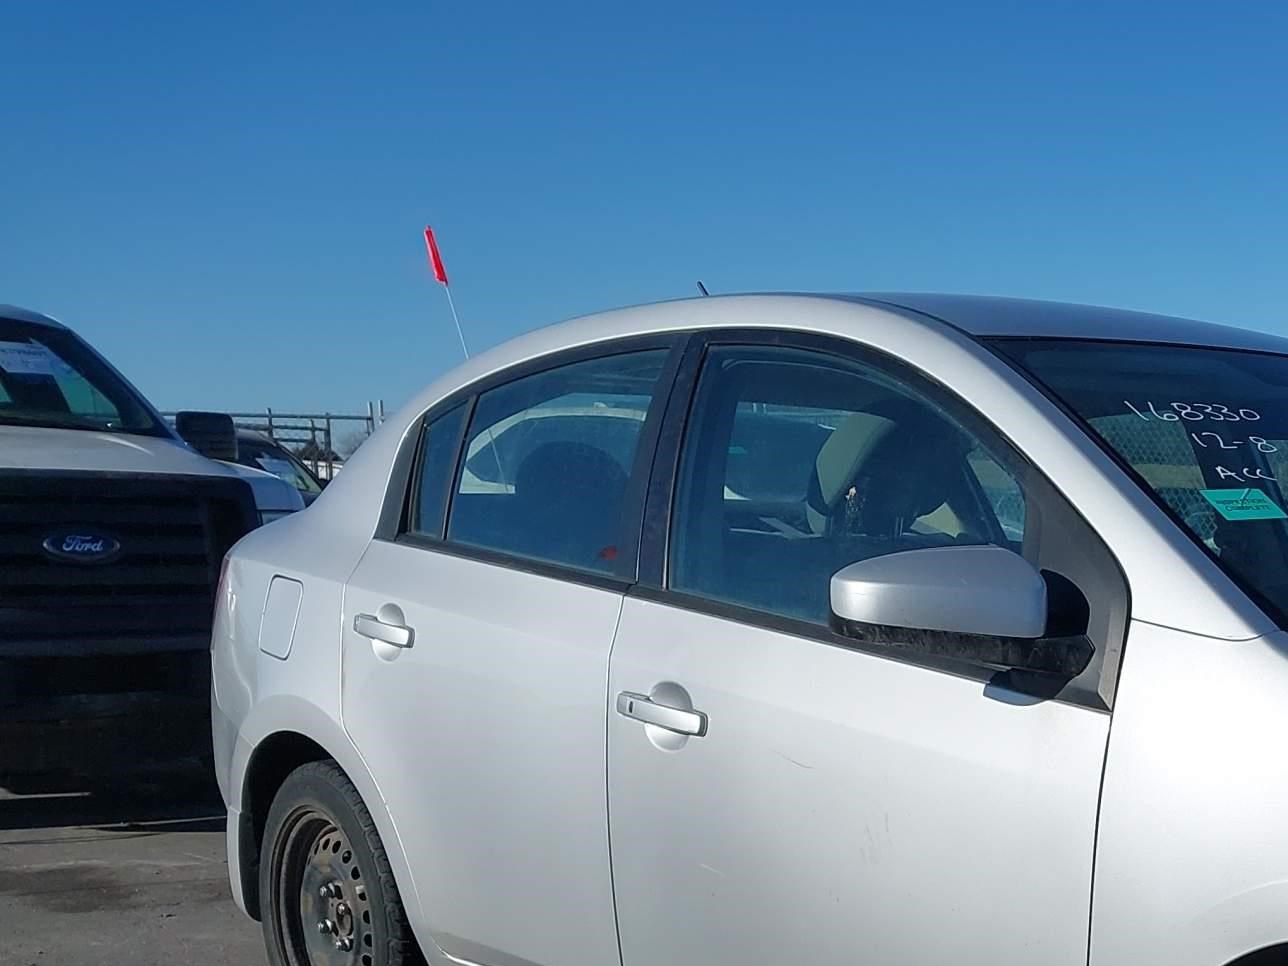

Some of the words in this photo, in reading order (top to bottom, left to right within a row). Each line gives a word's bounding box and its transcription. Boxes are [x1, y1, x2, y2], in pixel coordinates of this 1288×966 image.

[1124, 400, 1260, 421] 168330
[1191, 432, 1278, 453] 12-8
[62, 535, 103, 551] Ford
